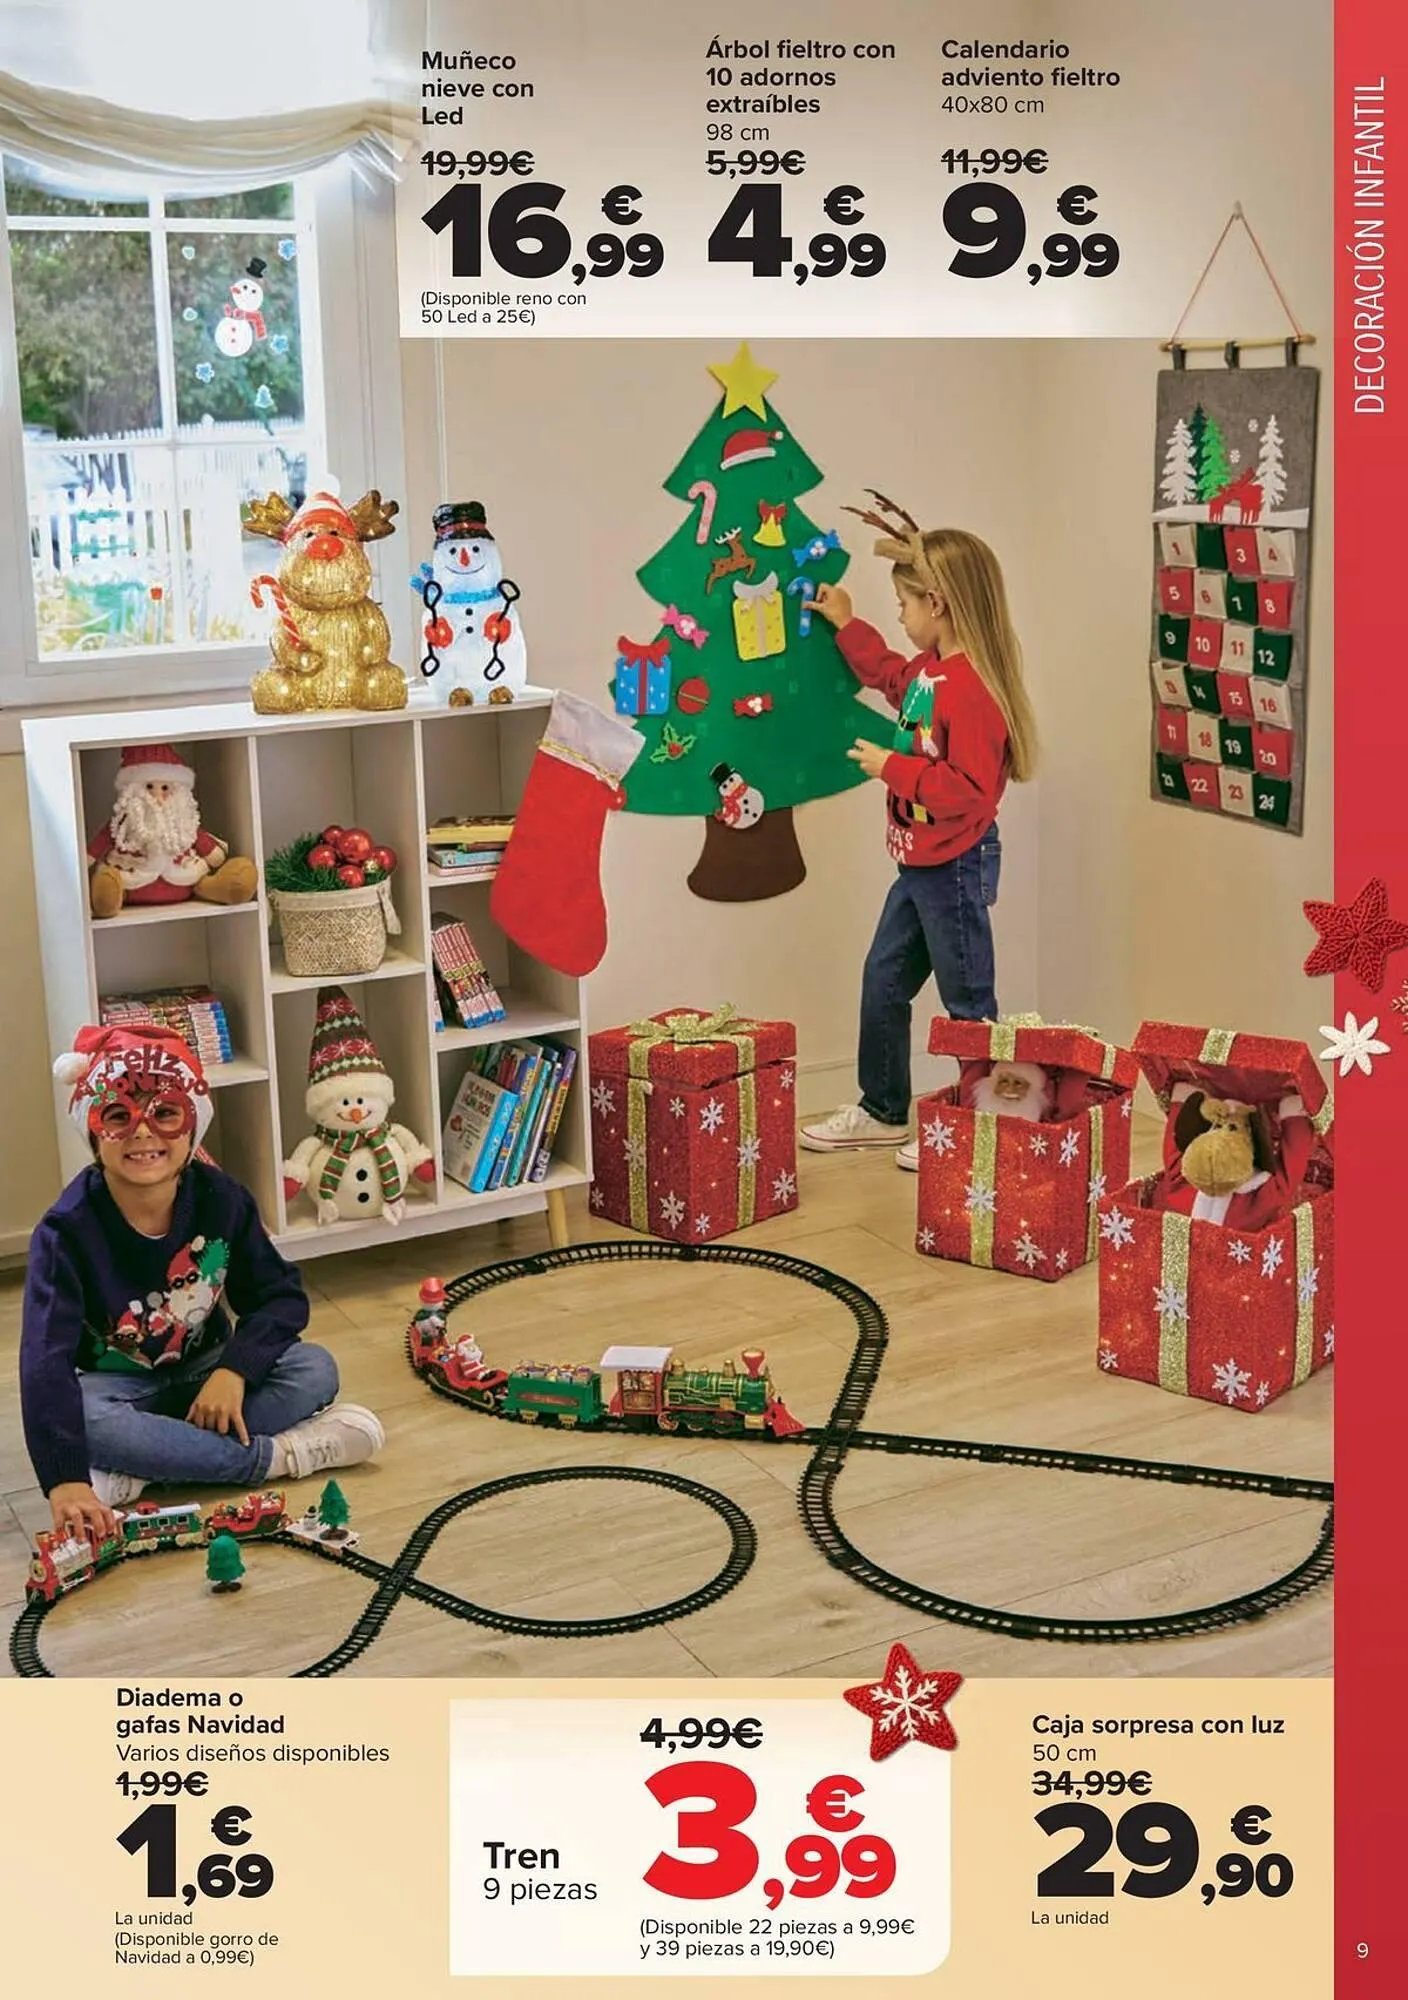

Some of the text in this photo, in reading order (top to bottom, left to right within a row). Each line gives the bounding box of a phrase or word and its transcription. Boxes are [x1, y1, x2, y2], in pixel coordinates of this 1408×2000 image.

[705, 34, 896, 59] Árbol fieltro con
[941, 38, 1070, 59] Calendario
[422, 49, 517, 71] Muñeco
[705, 67, 837, 87] 10 adornos
[941, 66, 1121, 87] adviento fieltro
[421, 77, 534, 98] nieve con
[705, 93, 821, 114] extraíbles
[941, 95, 1044, 114] 40x80 cm
[421, 106, 464, 126] Led
[706, 123, 770, 141] 98 cm
[419, 150, 536, 180] 19,99€
[704, 149, 807, 179] 5,99€
[940, 148, 1050, 178] 11,99€
[1346, 76, 1386, 414] DECORACIÓN INFANTIL
[420, 291, 587, 309] (Disponible reno con
[421, 309, 536, 326] 50 Led a 25€)
[1235, 548, 1247, 563] 3
[1268, 548, 1278, 562] 4
[1169, 586, 1276, 614] 5 6 7 8
[1165, 631, 1275, 666] 9 10 11 12
[1260, 698, 1277, 713] 16
[1198, 731, 1213, 748] 18
[1224, 739, 1242, 755] 19
[1259, 749, 1277, 766] 20
[1191, 778, 1209, 792] 22
[1228, 784, 1244, 800] 23
[1259, 794, 1275, 810] 24
[116, 1686, 244, 1707] Diadema o
[116, 1713, 285, 1739] gafas Navidad
[639, 1717, 764, 1754] 4,99€
[1032, 1713, 1285, 1739] Caja sorpresa con luz
[115, 1743, 390, 1766] Varios diseños disponibles
[1033, 1743, 1097, 1762] 50 cm
[114, 1770, 210, 1801] 1,99€
[1030, 1769, 1153, 1799] 34,99€
[482, 1841, 560, 1870] Tren
[483, 1877, 598, 1906] 9 piezas
[115, 1911, 193, 1926] La unidad
[1031, 1910, 1109, 1925] La unidad
[640, 1918, 915, 1939] (Disponible 22 piezas a 9,99€
[114, 1931, 279, 1949] (Disponible gorro de
[639, 1939, 835, 1960] y 39 piezas a 19,90€)
[115, 1949, 255, 1968] Navidad a 0,99€)
[1356, 1943, 1369, 1959] 9
